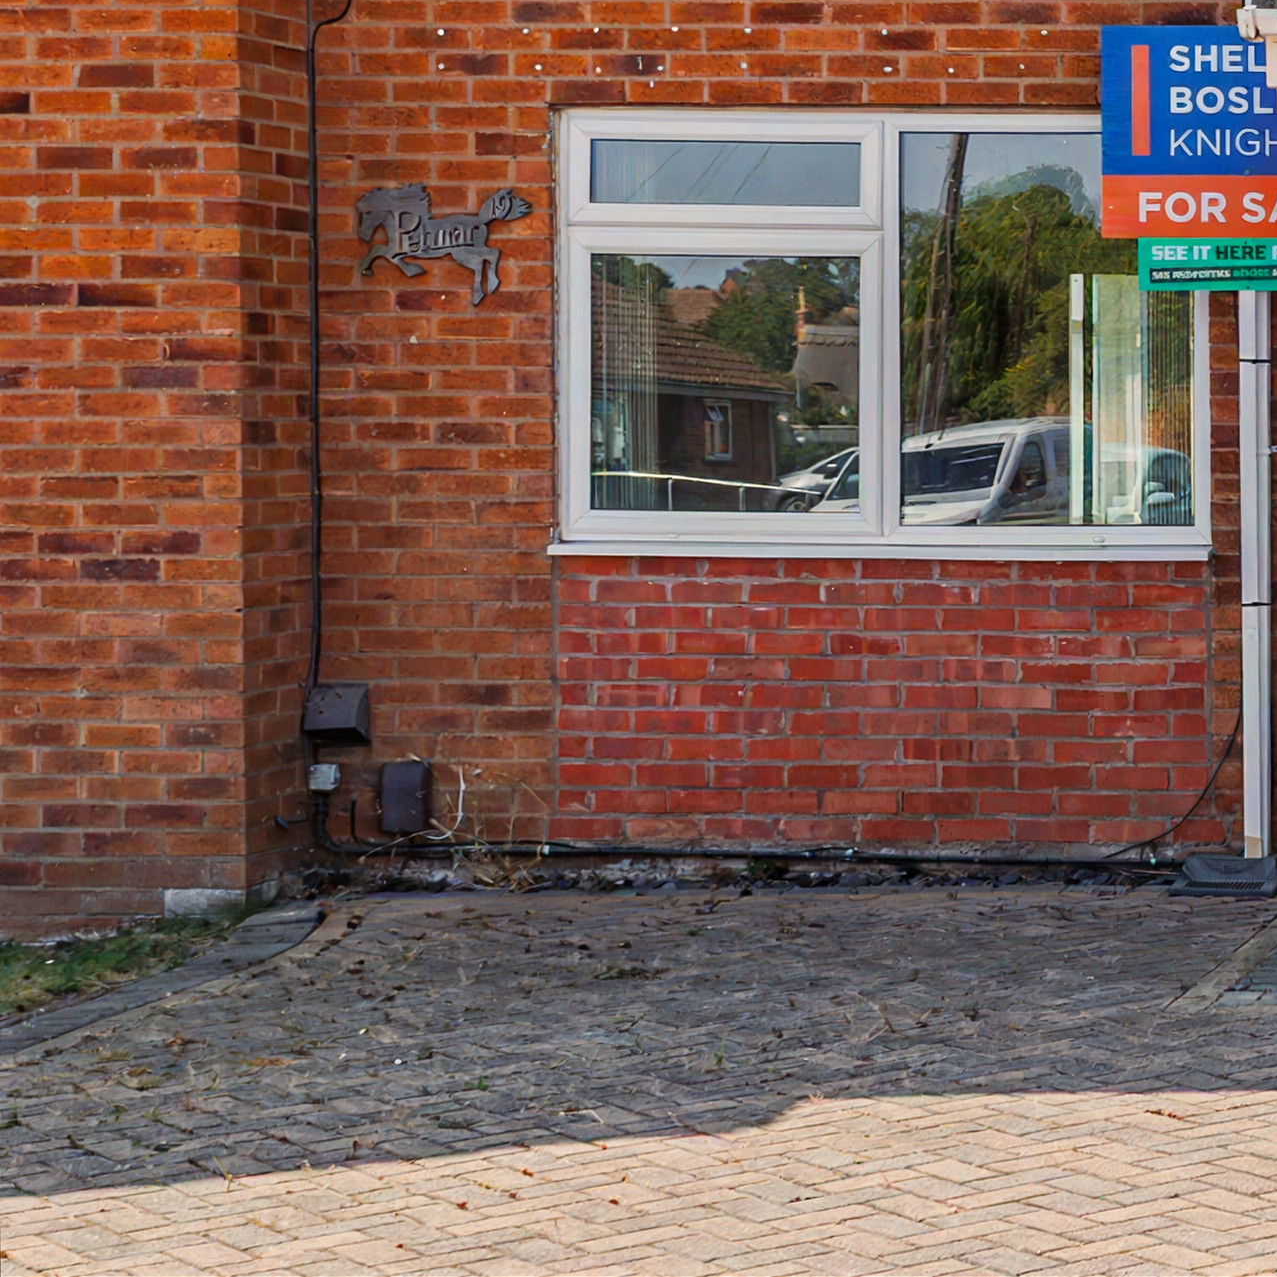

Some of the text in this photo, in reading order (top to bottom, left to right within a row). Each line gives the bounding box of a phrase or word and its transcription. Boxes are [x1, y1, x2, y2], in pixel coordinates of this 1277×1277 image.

[1169, 44, 1267, 73] SHEL
[1138, 191, 1227, 223] FOR
[1151, 245, 1188, 261] SEE
[1193, 245, 1211, 261] IT
[1215, 245, 1267, 260] HERE
